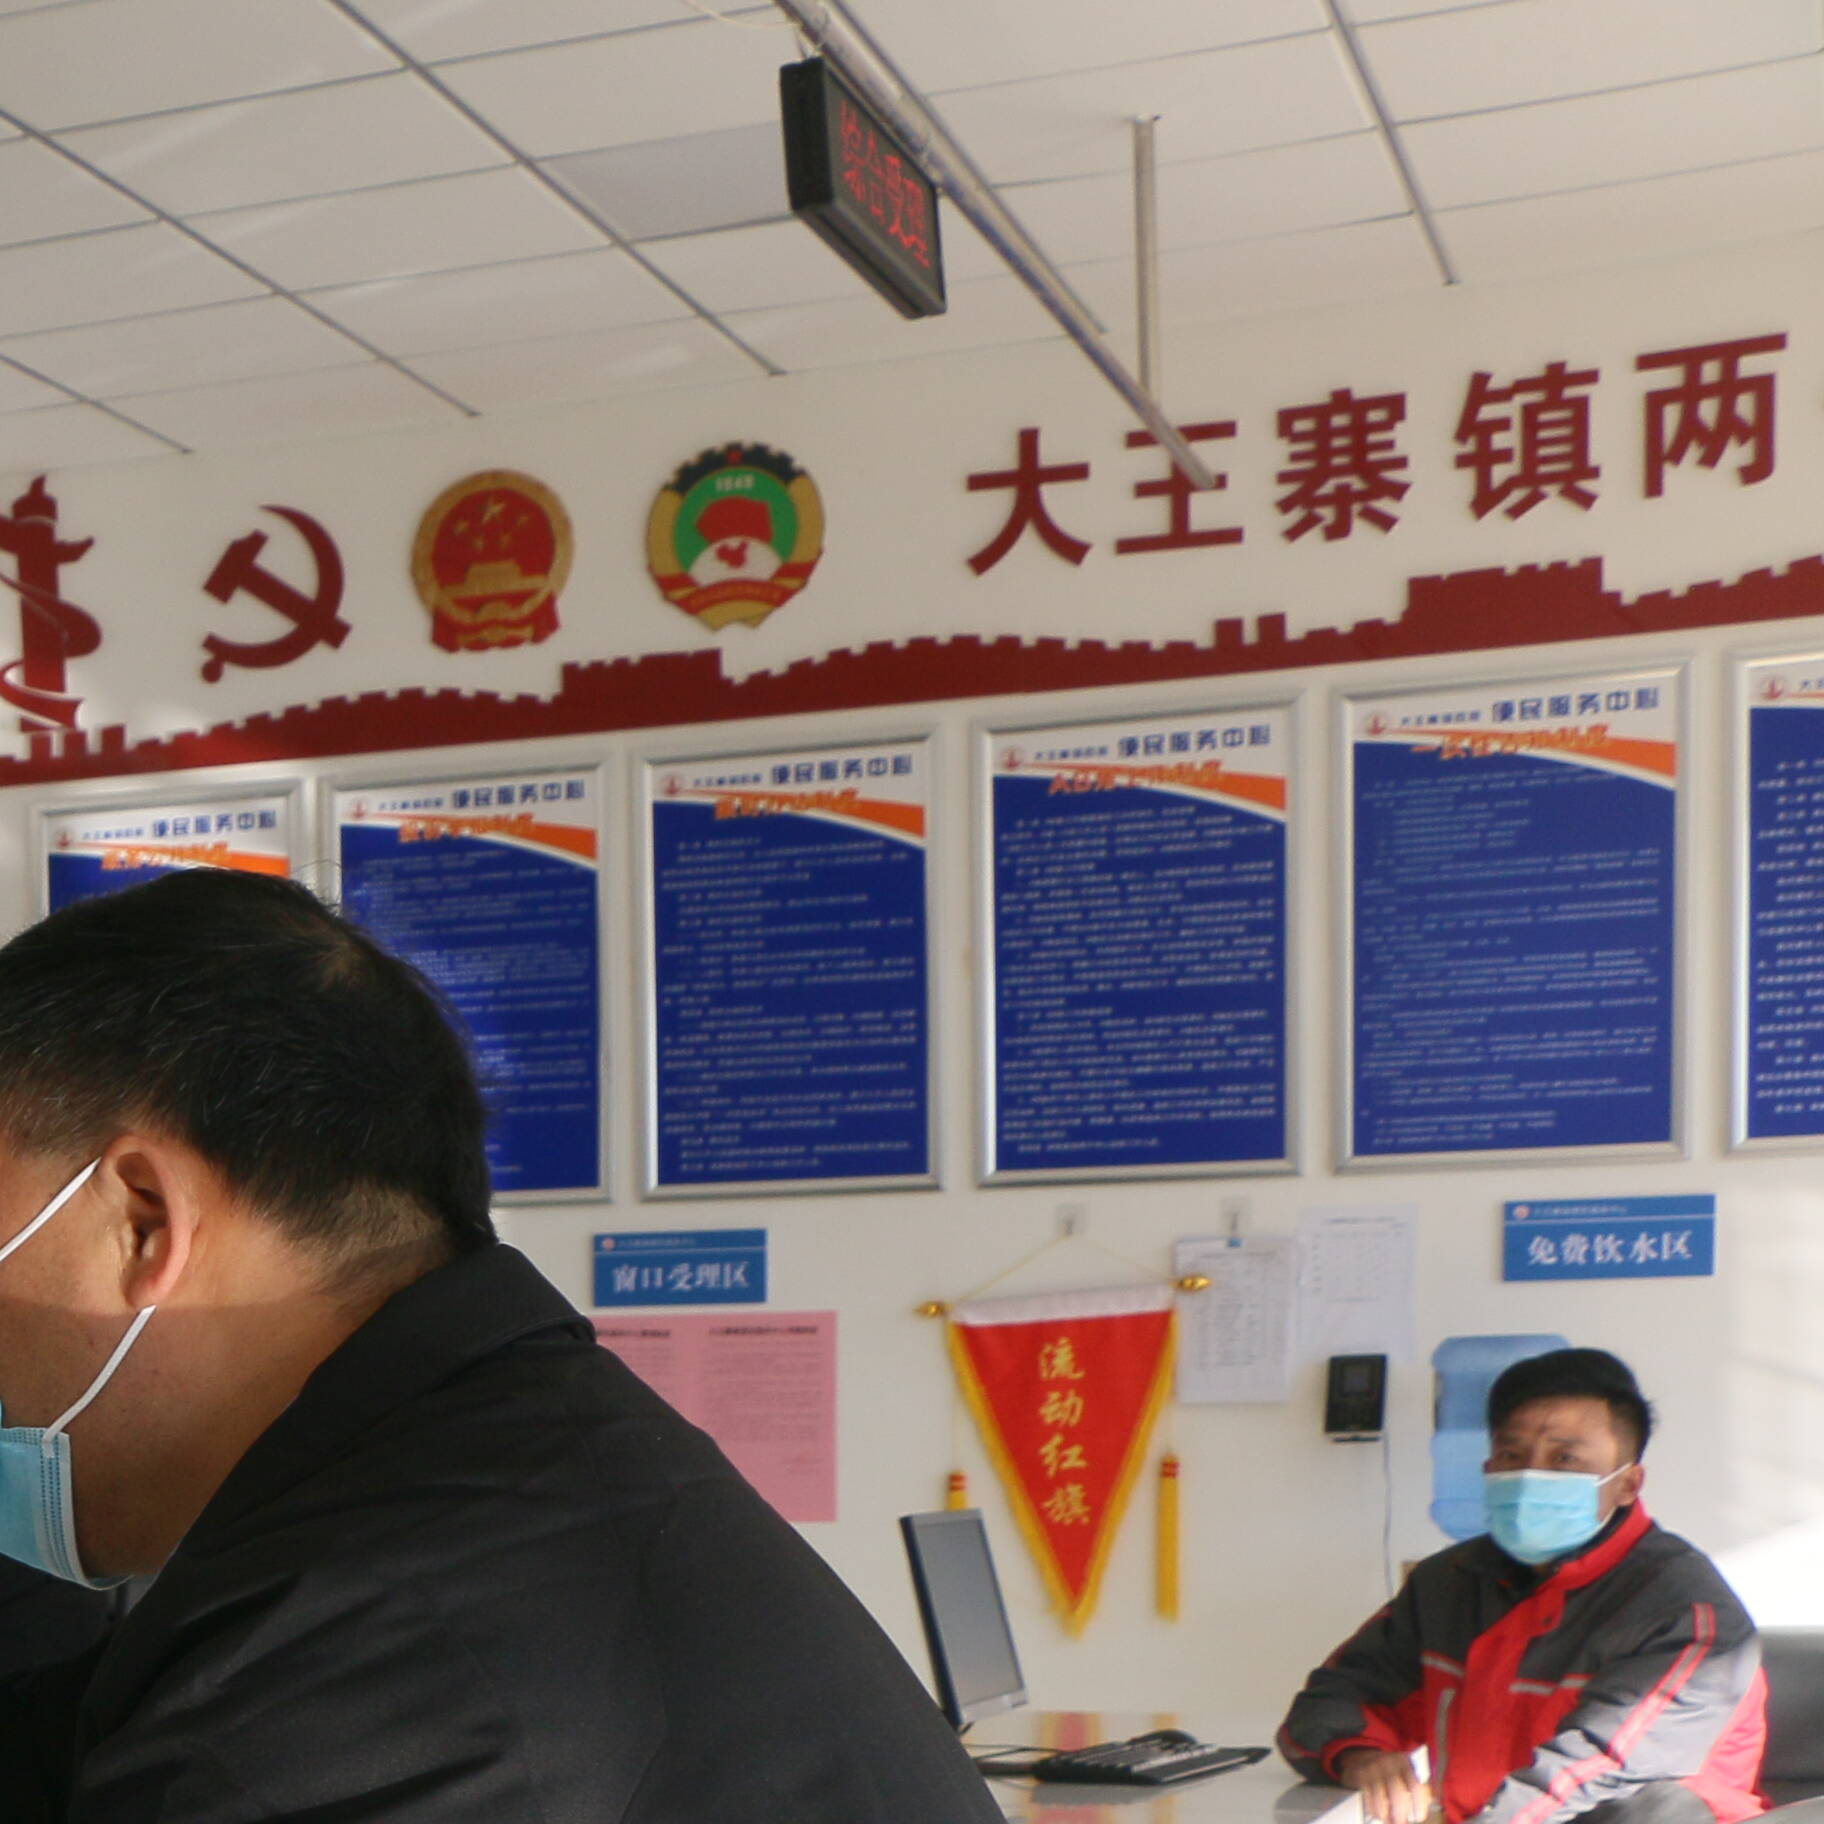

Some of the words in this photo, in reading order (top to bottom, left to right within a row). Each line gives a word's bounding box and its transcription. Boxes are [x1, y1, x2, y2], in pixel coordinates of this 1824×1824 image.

[966, 332, 1788, 577] 大王寨镇两
[611, 1261, 750, 1294] 窗口受理区
[1526, 1229, 1694, 1268] 免费饮水区
[1037, 1335, 1092, 1527] 流动红旗
